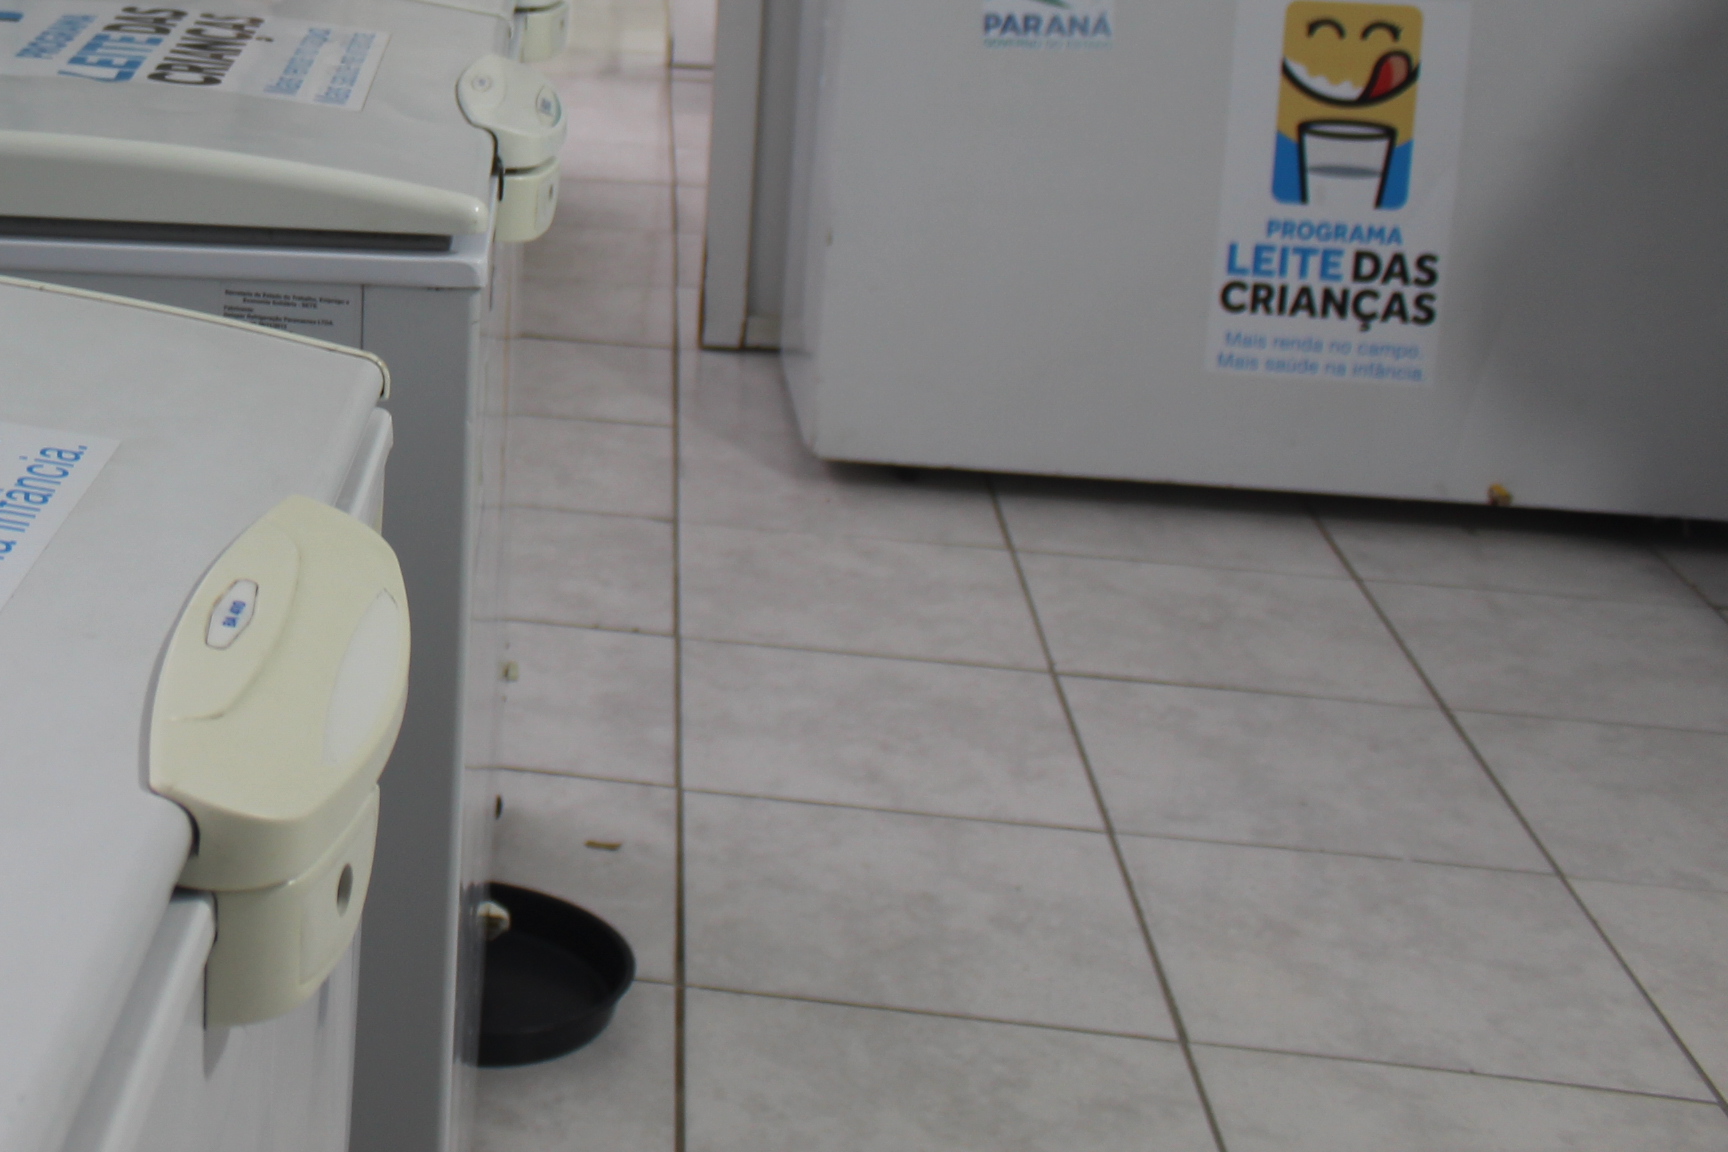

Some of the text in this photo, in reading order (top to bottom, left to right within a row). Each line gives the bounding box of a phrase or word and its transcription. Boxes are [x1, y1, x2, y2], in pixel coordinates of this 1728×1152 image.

[983, 11, 1112, 38] PARANÁ
[57, 5, 188, 84] LEITE DAS
[147, 12, 275, 87] CRIANÇAS
[1267, 219, 1403, 246] PROGRAMA
[1227, 242, 1440, 288] LEITE DAS
[1220, 280, 1438, 333] CRIANÇAS
[1225, 331, 1267, 349] Mais
[1329, 341, 1353, 355] no
[1218, 352, 1260, 371] Mais
[1325, 363, 1347, 376] na
